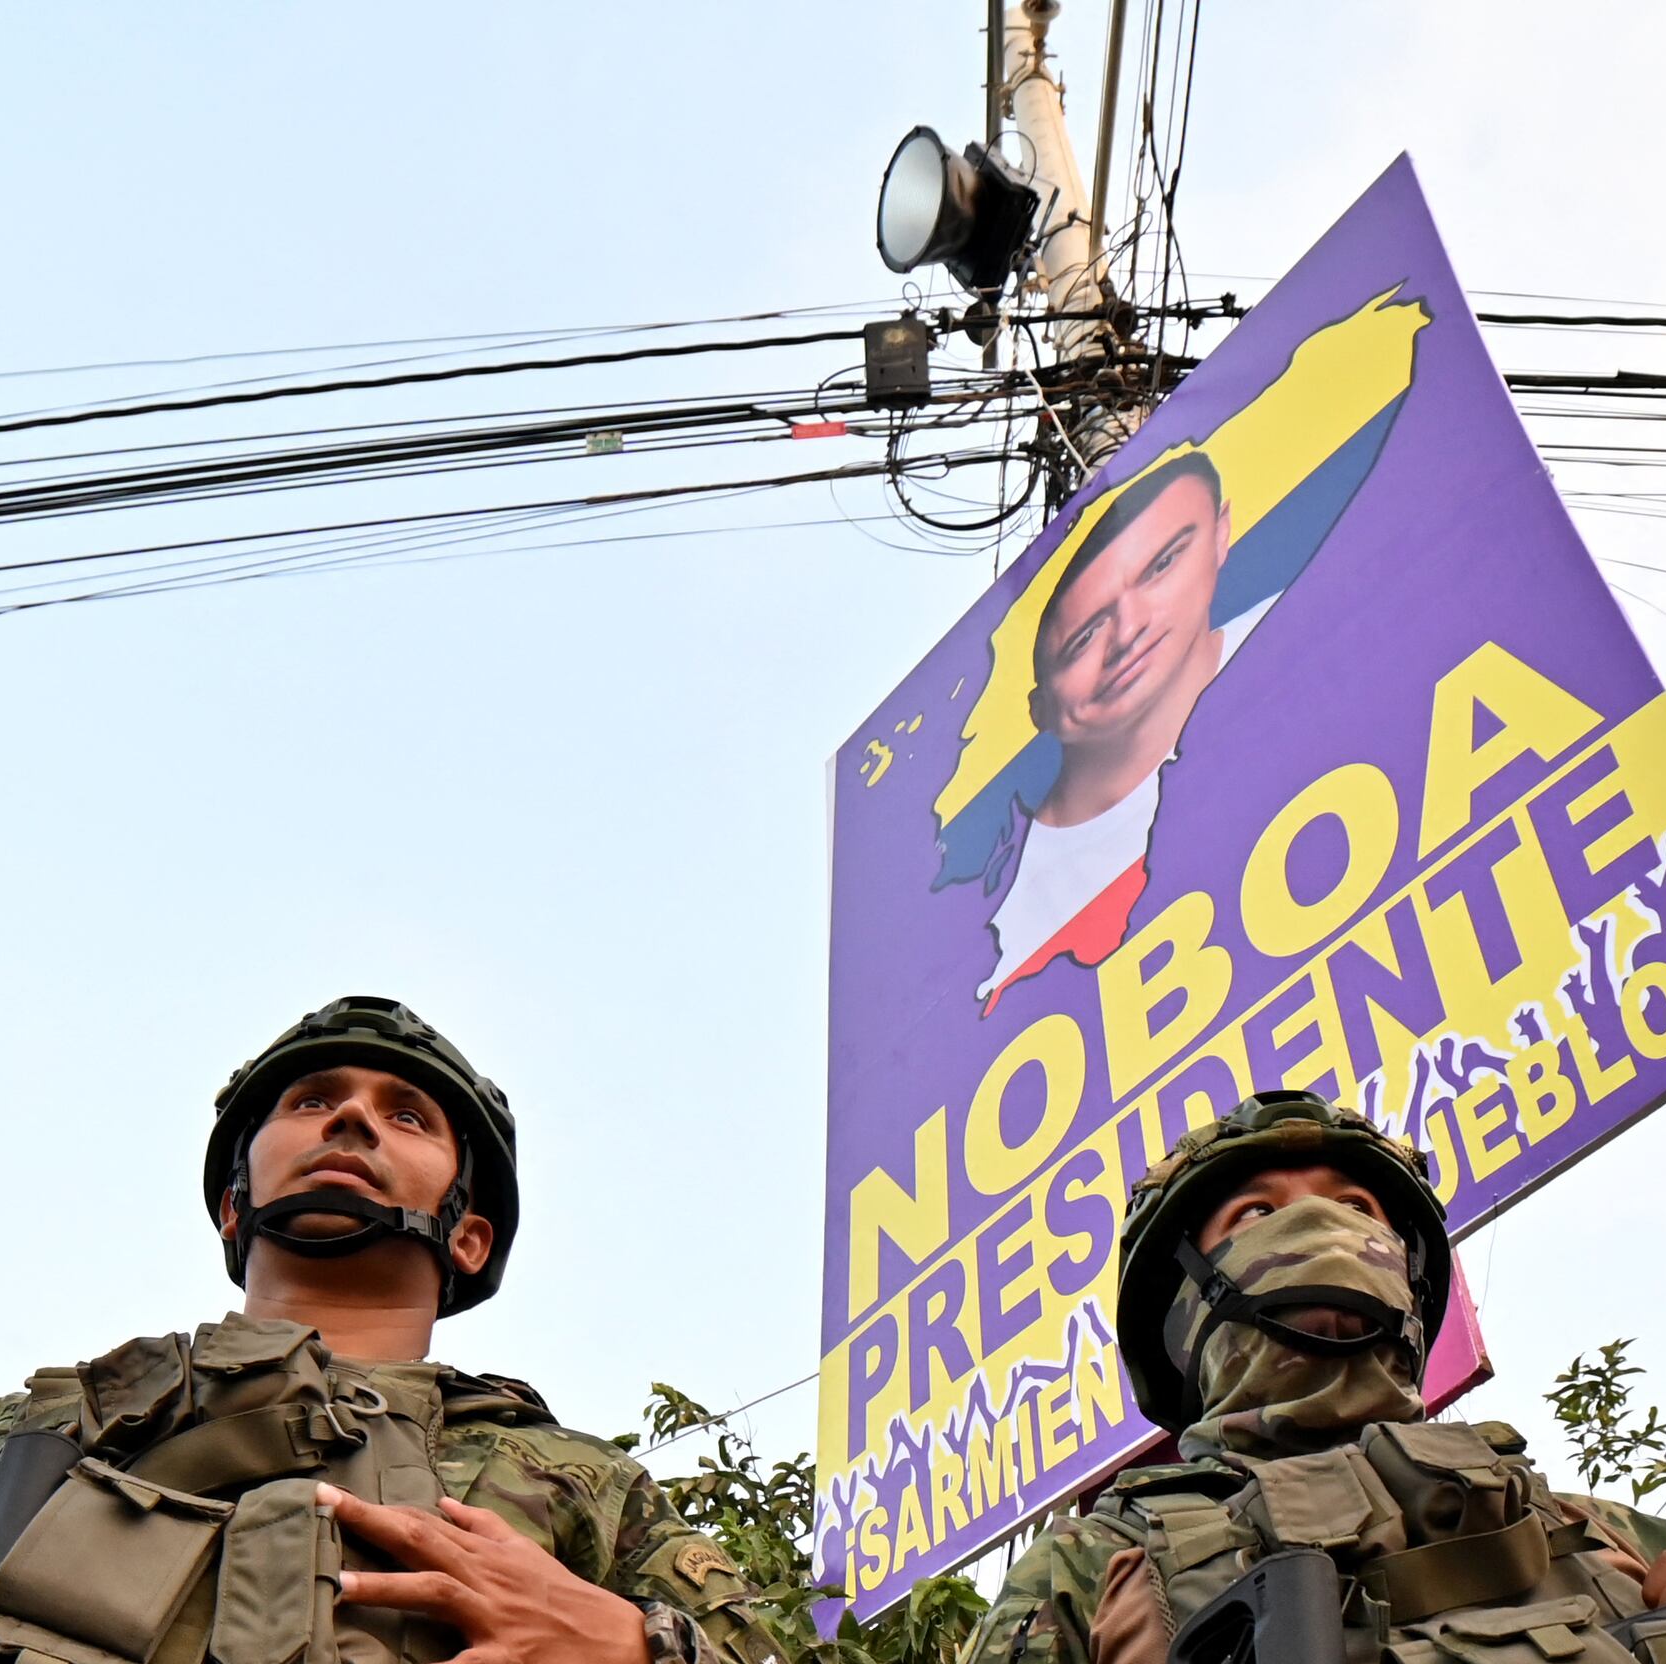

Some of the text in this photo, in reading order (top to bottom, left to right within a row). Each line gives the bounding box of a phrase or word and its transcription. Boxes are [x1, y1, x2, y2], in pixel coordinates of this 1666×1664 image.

[847, 742, 1659, 1464] PRESIDENTE
[848, 640, 1606, 1322] NOBOA
[844, 1339, 1126, 1608] ¡SARMIEN
